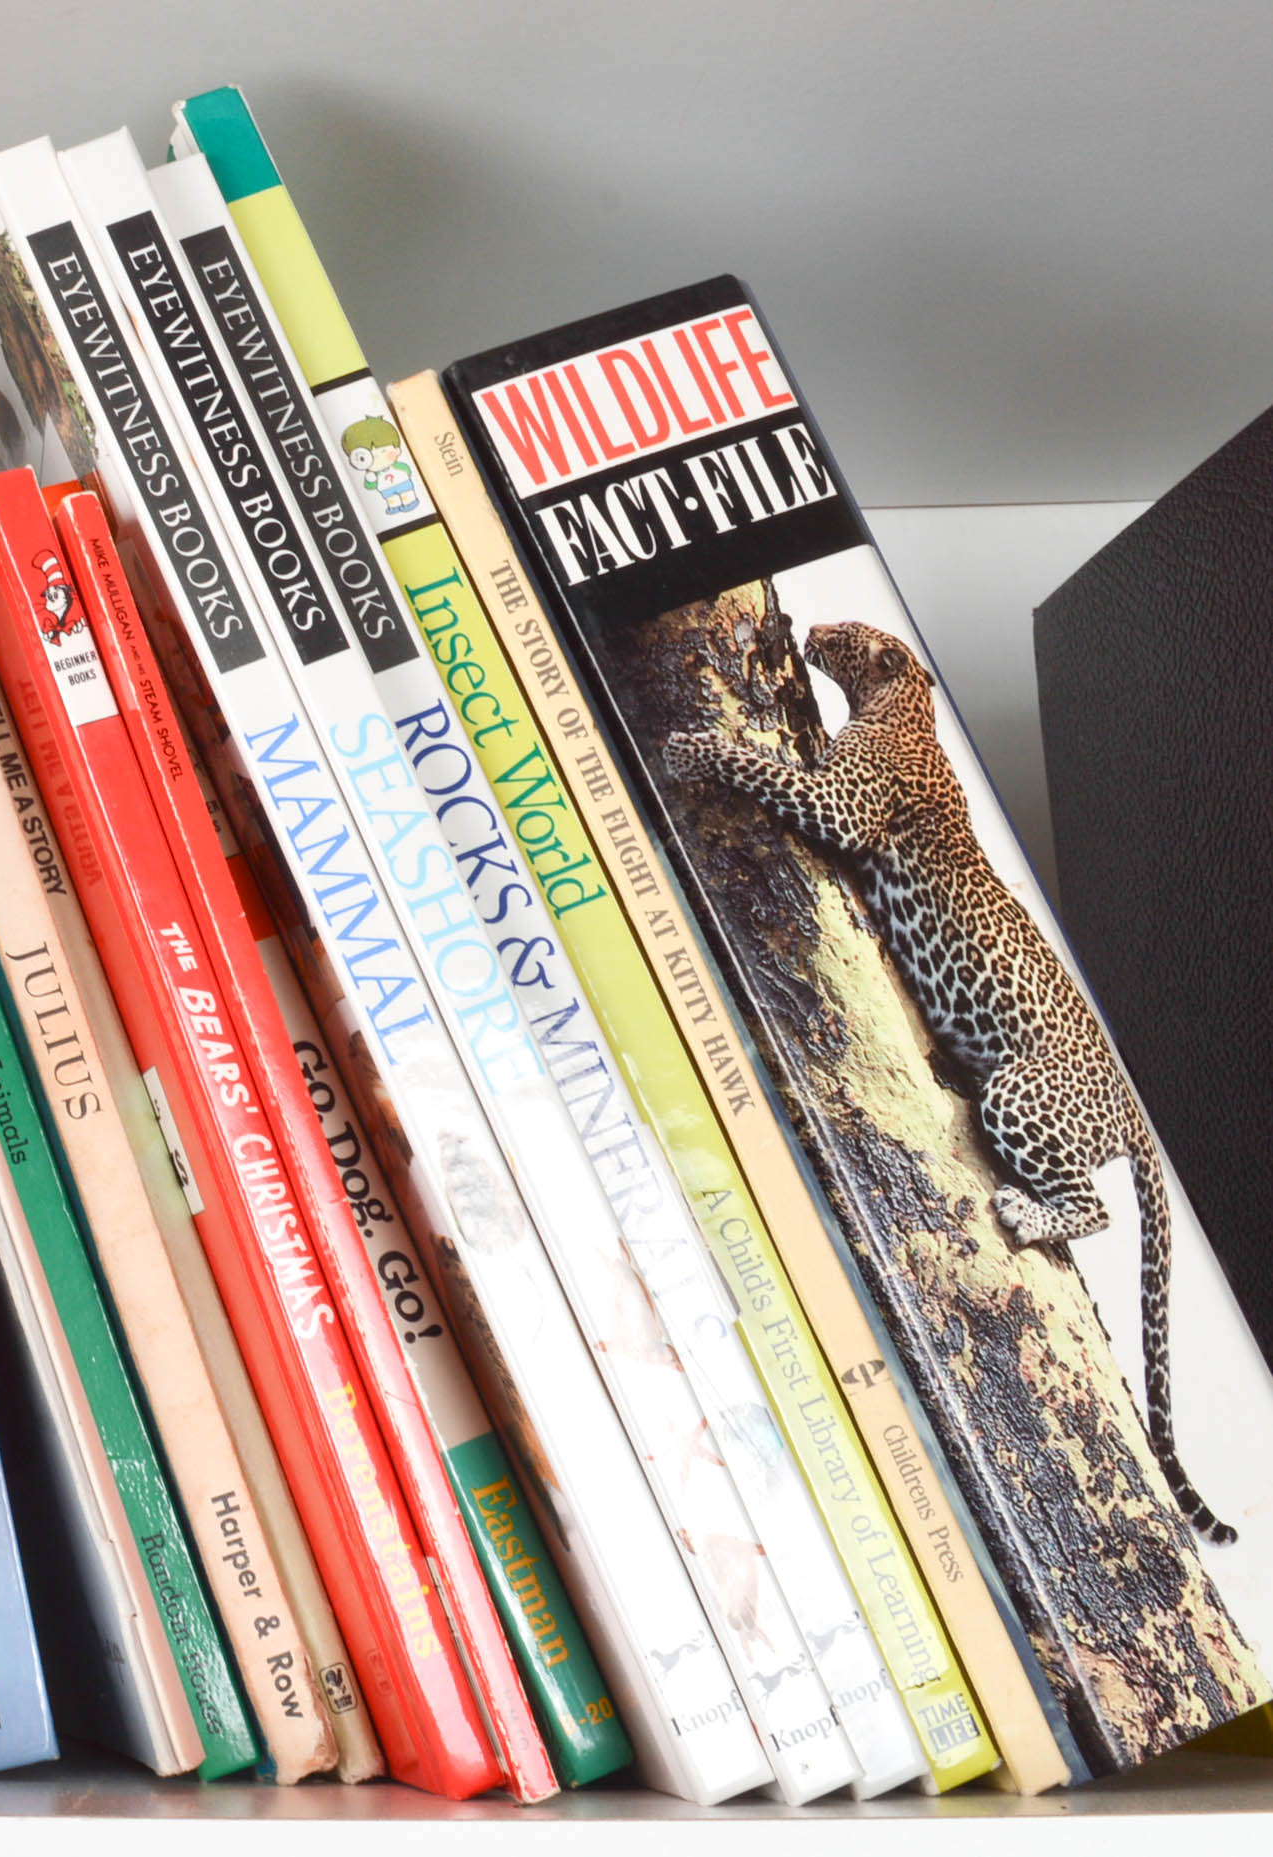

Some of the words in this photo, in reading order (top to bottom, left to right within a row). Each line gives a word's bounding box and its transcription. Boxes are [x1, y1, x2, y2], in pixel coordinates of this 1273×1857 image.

[48, 251, 180, 497] EYEWITNESS
[159, 500, 243, 640] BOOKS
[128, 241, 261, 488] EYEWITNESS
[240, 491, 326, 632] BOOKS
[202, 257, 332, 499] EYEWITNESS
[312, 502, 396, 640] BOOKS
[481, 309, 794, 486] WILDLIFE
[433, 430, 464, 478] Stein
[54, 650, 98, 673] BEGINNER
[68, 668, 98, 687] BOOKS
[89, 538, 110, 569] MIKE
[102, 573, 136, 642] MULLIGAN
[140, 679, 164, 724] STEAM
[156, 727, 184, 782] SHOVEL
[0, 751, 28, 792] ME
[404, 566, 520, 749] Insect
[493, 741, 608, 920] World
[14, 795, 35, 815] A
[21, 814, 67, 897] STORY
[490, 559, 529, 615] THE
[515, 617, 571, 700] STORY
[557, 706, 590, 742] OF
[575, 746, 616, 803] THE
[600, 806, 662, 899] FLIGHT
[644, 906, 680, 945] AT
[664, 946, 718, 1027] KITTY
[703, 1032, 756, 1117] HAWK
[243, 711, 435, 1066] MAMMAL
[328, 712, 546, 1097] SEASHORE
[159, 921, 199, 973] THE
[5, 941, 104, 1121] JULIUS
[178, 986, 259, 1114] BEARS'
[395, 698, 533, 925] ROCKS
[497, 936, 556, 990] &
[529, 997, 727, 1340] MINERA
[231, 1133, 335, 1340] CHRISTMAS
[702, 1188, 732, 1213] A
[762, 1314, 812, 1392] First
[798, 1392, 862, 1505] Library
[882, 1423, 937, 1522] Childrens
[927, 1524, 965, 1584] Press
[211, 1490, 263, 1600] Harper
[321, 1381, 442, 1659] Berenstains
[470, 1475, 570, 1669] Eastman
[850, 1514, 888, 1545] of
[253, 1614, 281, 1640] &
[866, 1547, 942, 1690] Learning
[266, 1650, 304, 1720] Row
[670, 1687, 747, 1737] Knopf
[770, 1703, 841, 1752] Knopf
[830, 1667, 892, 1709] nopf
[917, 1692, 970, 1727] TIME
[929, 1714, 980, 1753] LIFE
